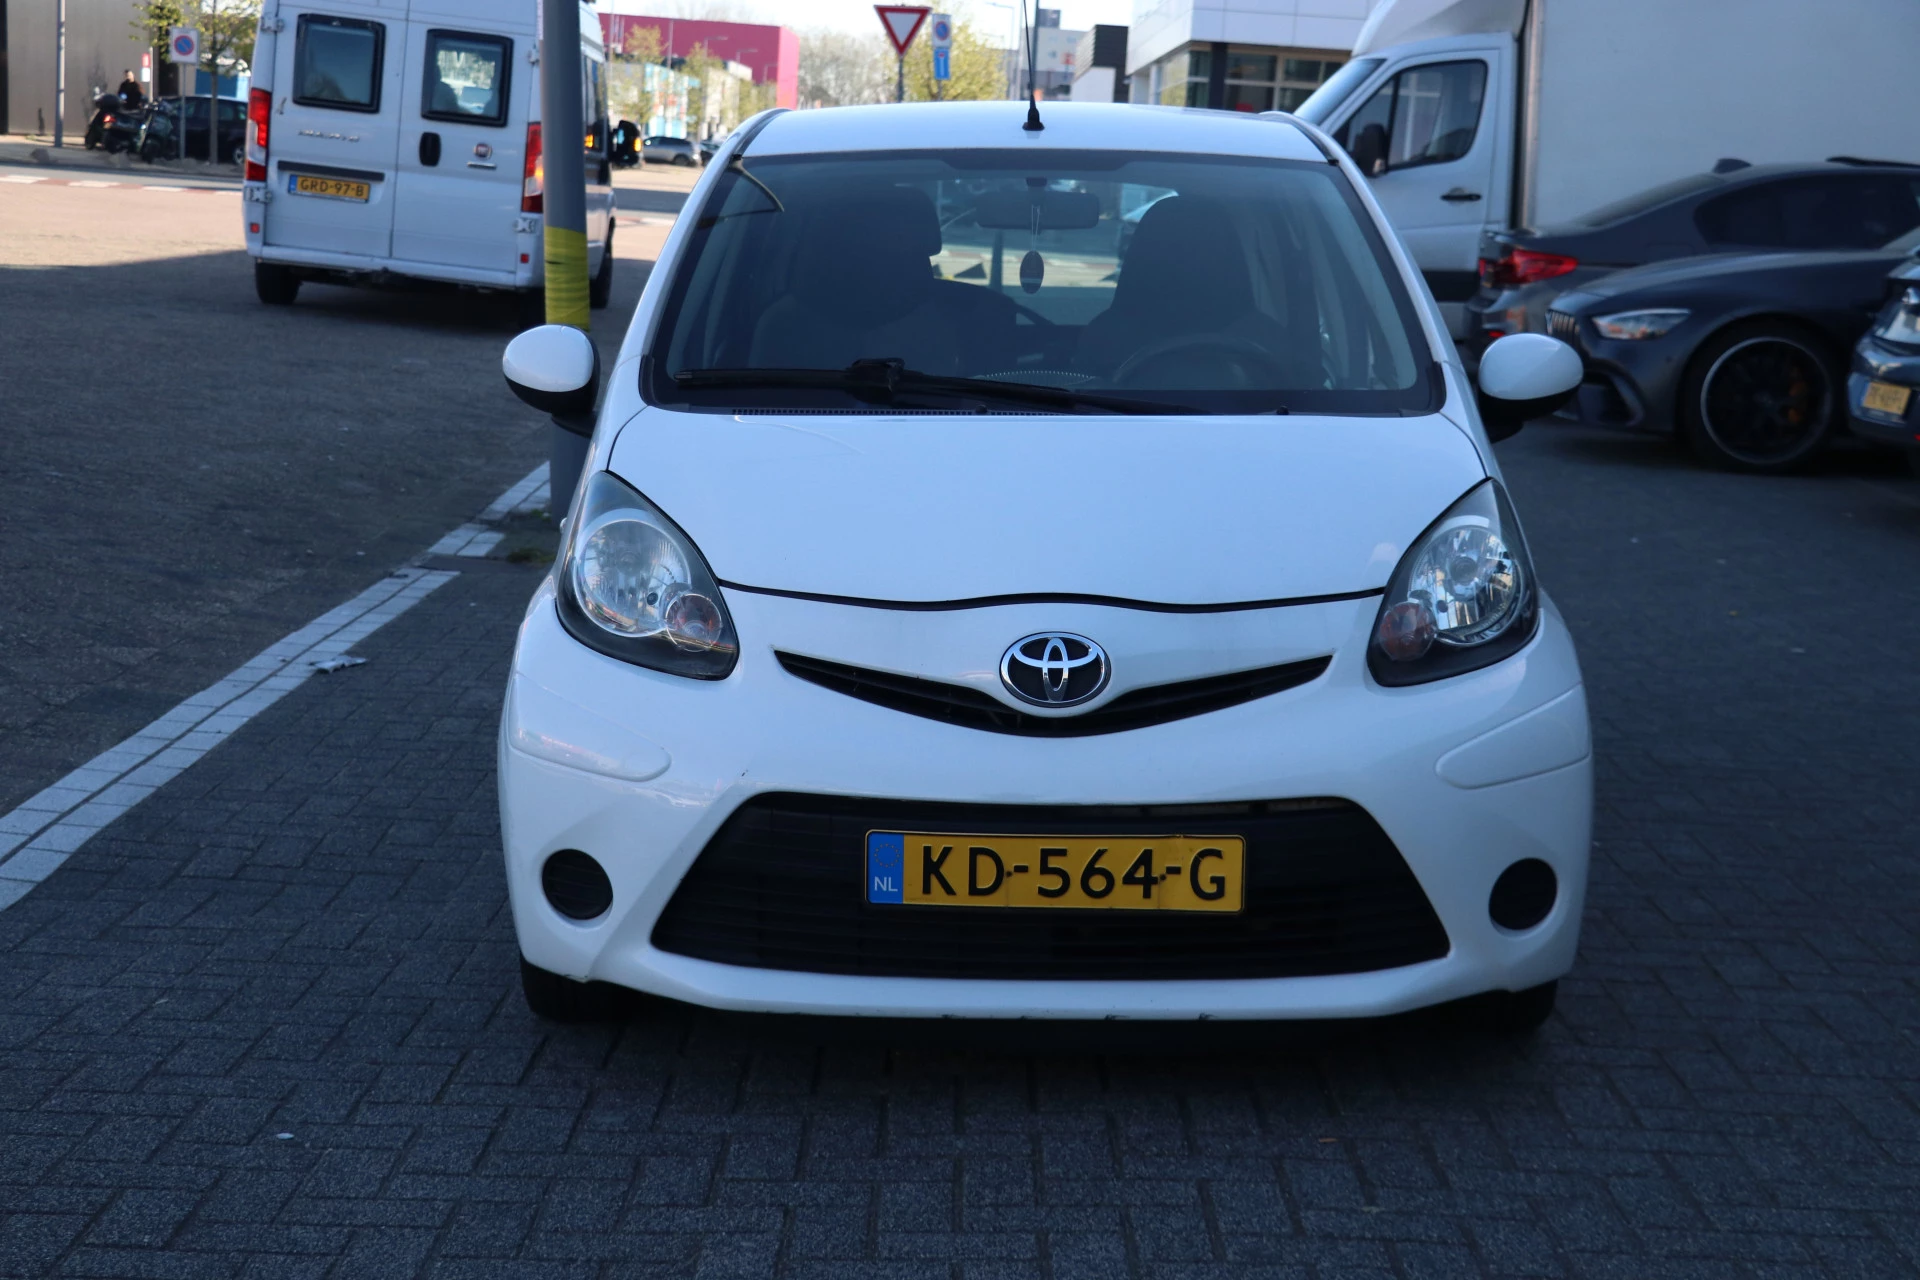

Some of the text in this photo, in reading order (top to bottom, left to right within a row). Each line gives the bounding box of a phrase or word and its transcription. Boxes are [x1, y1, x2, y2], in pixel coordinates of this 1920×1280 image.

[300, 179, 364, 197] GRD-97-B
[922, 845, 1226, 900] KD-564-G
[874, 876, 898, 892] NL
